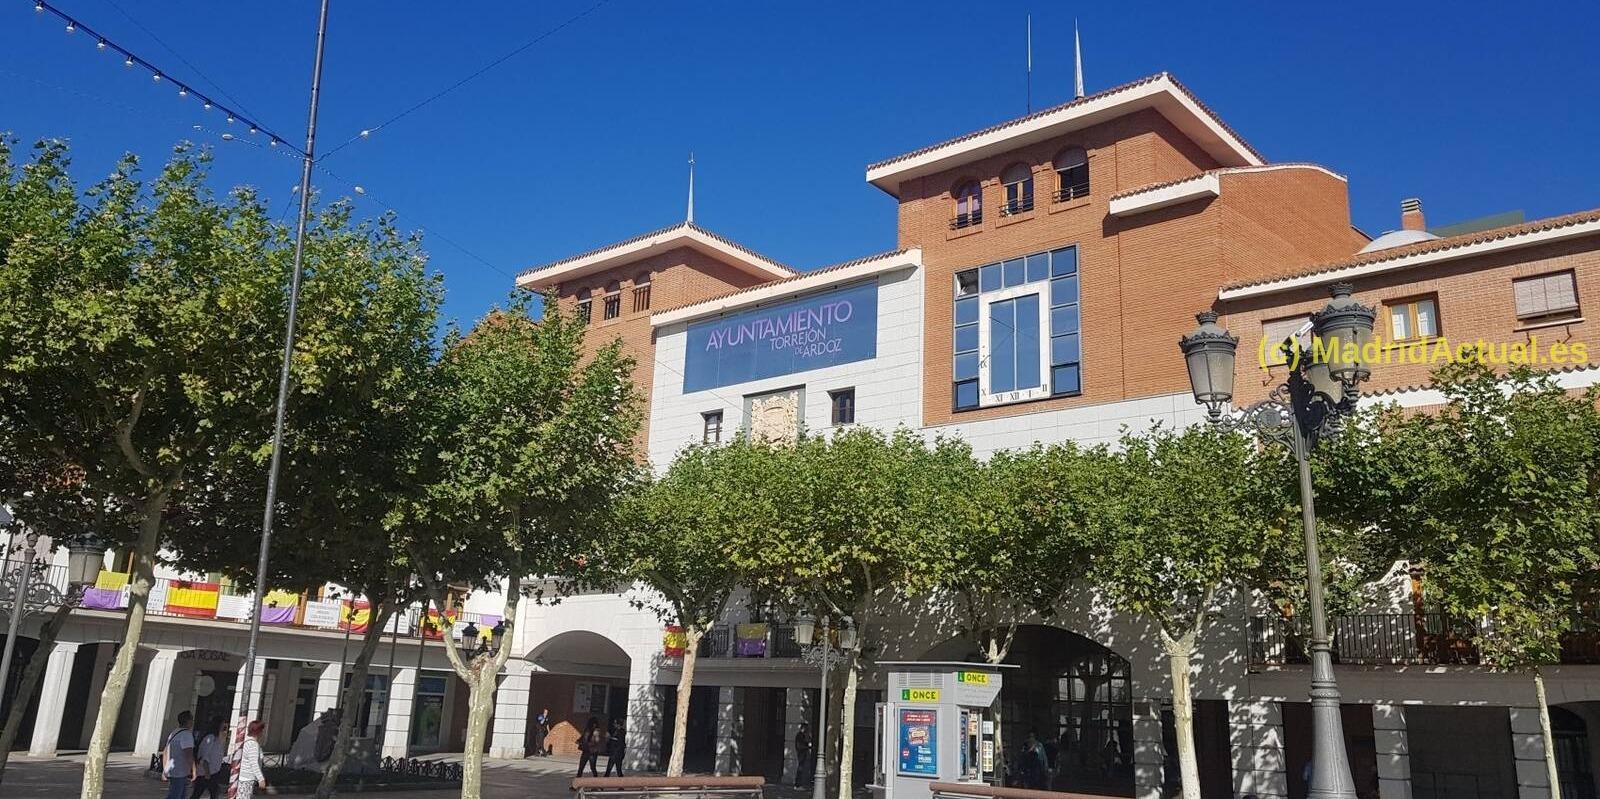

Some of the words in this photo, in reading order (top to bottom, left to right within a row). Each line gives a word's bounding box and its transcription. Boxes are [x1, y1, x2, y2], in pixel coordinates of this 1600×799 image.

[706, 300, 853, 351] AYUNTAMIENTO
[770, 328, 826, 350] TORREJÓN
[802, 338, 842, 358] ARDOZ
[1010, 391, 1020, 401] XII
[965, 673, 986, 683] ONCE
[912, 690, 936, 700] ONCE
